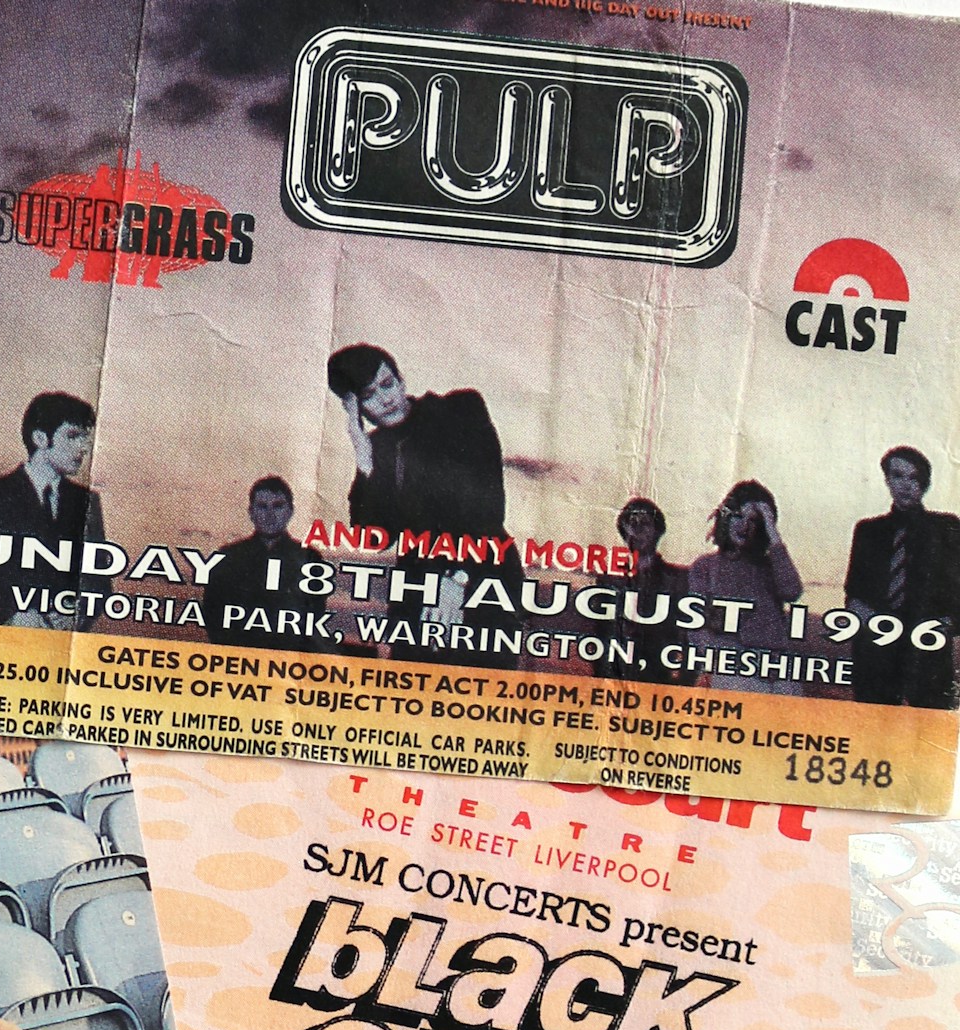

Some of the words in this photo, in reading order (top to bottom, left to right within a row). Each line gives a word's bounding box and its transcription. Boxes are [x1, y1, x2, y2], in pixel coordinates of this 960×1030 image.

[331, 67, 701, 220] PULP
[785, 304, 907, 354] CAST
[304, 519, 391, 553] AND
[397, 526, 514, 567] MANY
[524, 537, 639, 577] MORE!
[11, 585, 207, 628] VICTORIA
[222, 604, 344, 646] PARK,
[356, 617, 647, 671] WARRINGTON,
[660, 643, 855, 686] CHESHIRE
[266, 559, 438, 605] 18TH
[464, 578, 753, 633] AUGUST
[789, 607, 947, 652] 1996
[56, 666, 184, 695] INCLUSIVE
[190, 679, 224, 698] OF
[226, 682, 273, 702] VAT
[284, 687, 388, 713] SUBJECT
[390, 696, 424, 716] TO
[431, 700, 547, 727] BOOKING
[553, 710, 599, 731] FEE.
[608, 715, 712, 742] SUBJECT
[714, 724, 747, 746] TO
[752, 729, 851, 754] LICENSE
[97, 645, 180, 670] GATES
[187, 653, 260, 677] OPEN
[267, 660, 355, 689] NOON,
[360, 668, 432, 692] FIRST
[434, 675, 490, 697] ACT
[496, 680, 585, 709] 2.00PM,
[590, 687, 641, 710] END
[651, 693, 743, 720] 10.45PM
[19, 698, 92, 720] PARKING
[100, 705, 115, 722] IS
[122, 707, 164, 726] VERY
[171, 711, 244, 733] LIMITED.
[251, 718, 284, 736] USE
[291, 721, 337, 741] ONLY
[344, 726, 422, 749] OFFICIAL
[431, 734, 465, 753] CAR
[474, 737, 530, 758] PARKS.
[68, 723, 130, 744] PARKED
[134, 729, 152, 747] IN
[156, 731, 277, 757] SURROUNDING
[279, 741, 350, 765] STREETS
[351, 748, 392, 767] WILL
[396, 752, 417, 769] BE
[419, 754, 479, 775] TOWED
[481, 759, 529, 778] AWAY
[554, 742, 618, 764] SUBJECT
[618, 747, 640, 765] TO
[643, 750, 742, 775] CONDITIONS
[600, 767, 624, 784] ON
[627, 769, 691, 792] REVERSE
[785, 753, 892, 788] 18348
[361, 806, 414, 837] ROE
[430, 821, 520, 860] STREET
[535, 843, 673, 892] LIVERPOOL
[303, 842, 389, 887] SJM
[398, 863, 611, 933] CONCERTS
[622, 917, 758, 966] present
